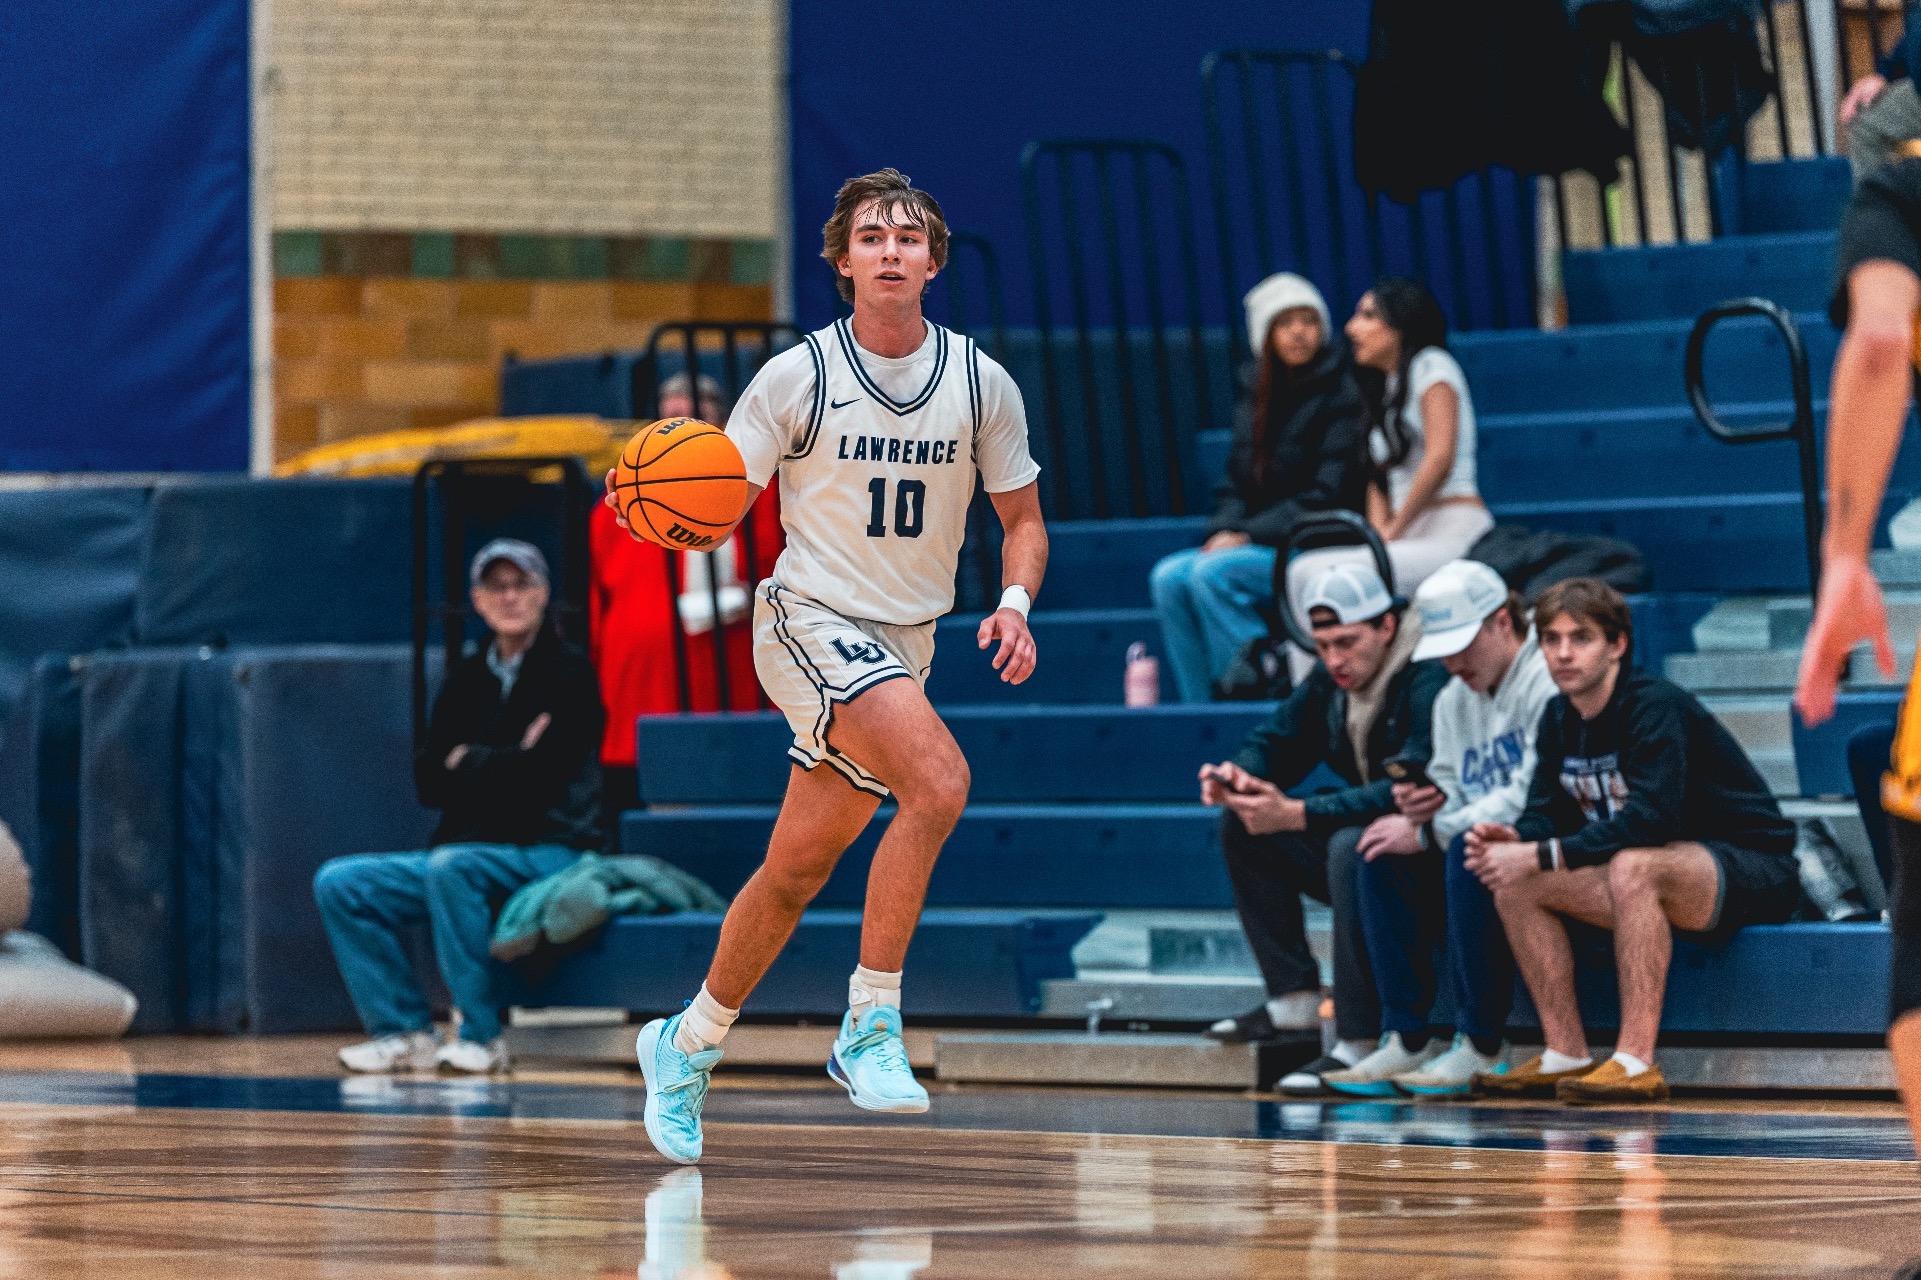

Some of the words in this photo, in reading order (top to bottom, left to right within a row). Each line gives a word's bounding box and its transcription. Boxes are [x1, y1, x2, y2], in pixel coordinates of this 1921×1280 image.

[838, 435, 958, 465] LAWRENCE
[867, 477, 926, 538] 10
[666, 522, 713, 547] Wil
